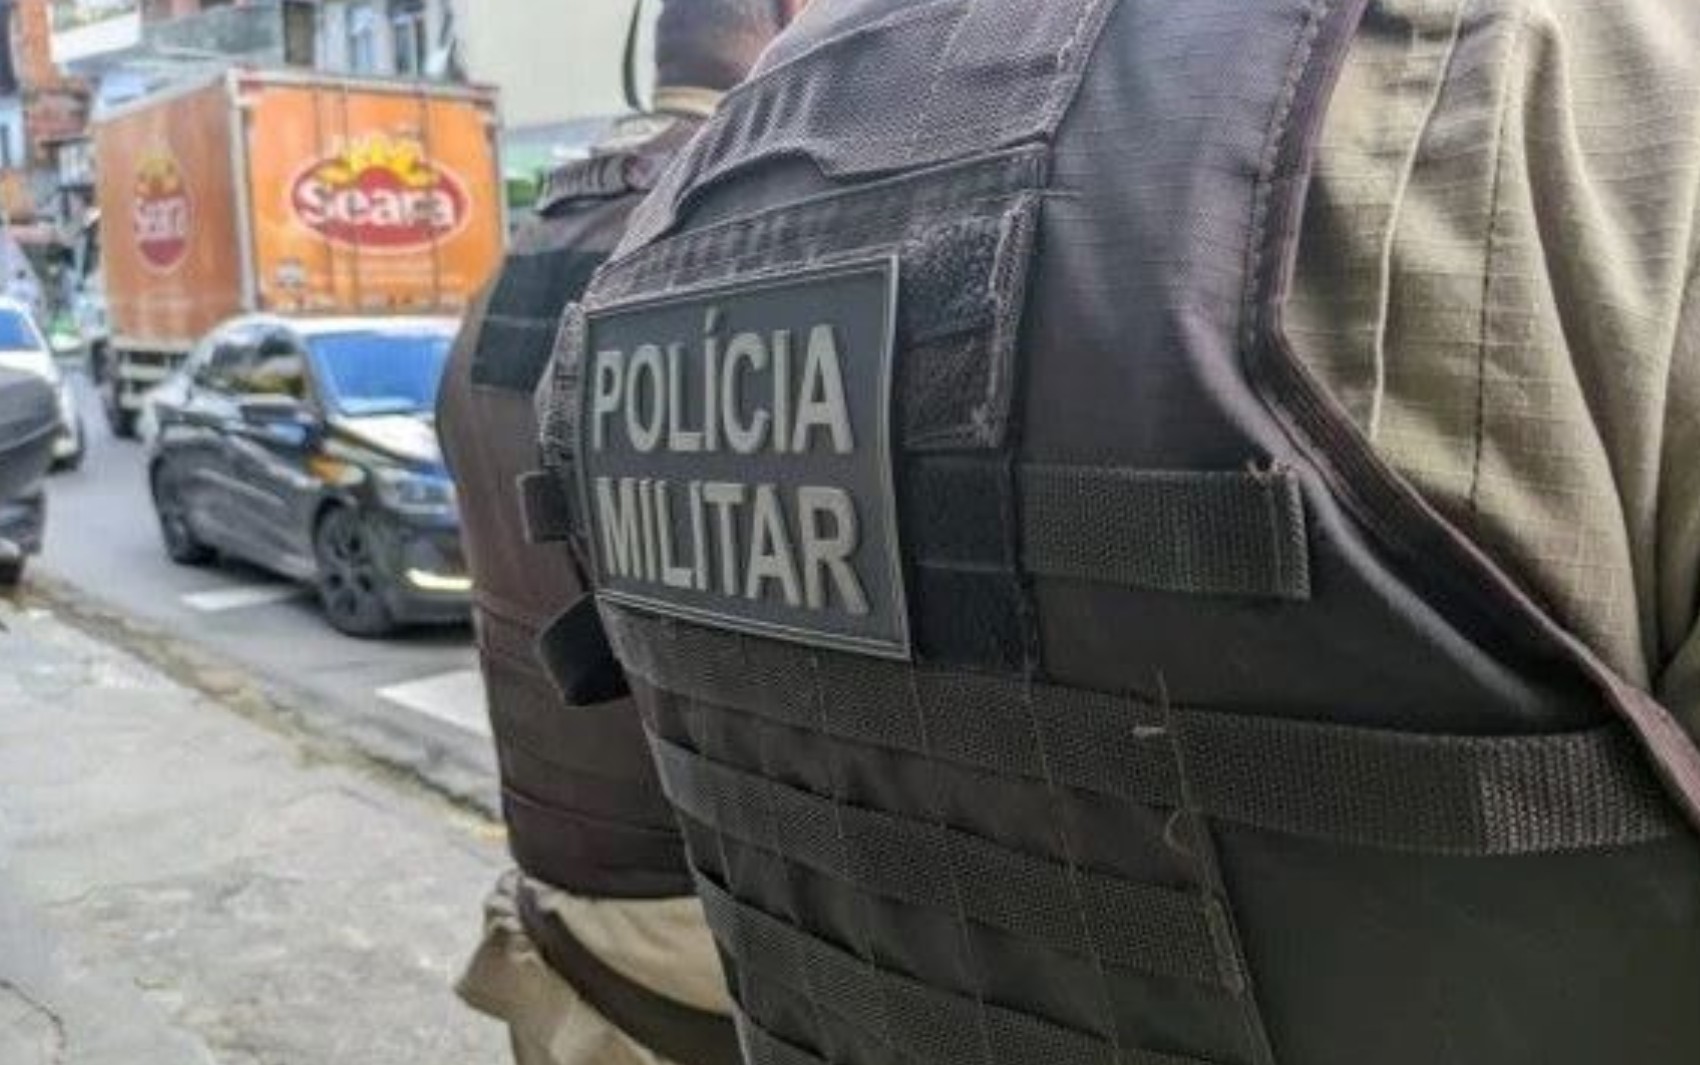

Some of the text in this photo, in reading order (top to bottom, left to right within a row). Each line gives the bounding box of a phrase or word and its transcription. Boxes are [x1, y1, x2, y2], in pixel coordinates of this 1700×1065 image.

[298, 180, 457, 227] Seara
[594, 307, 854, 454] POLÍCIA
[597, 477, 869, 614] MILITAR
